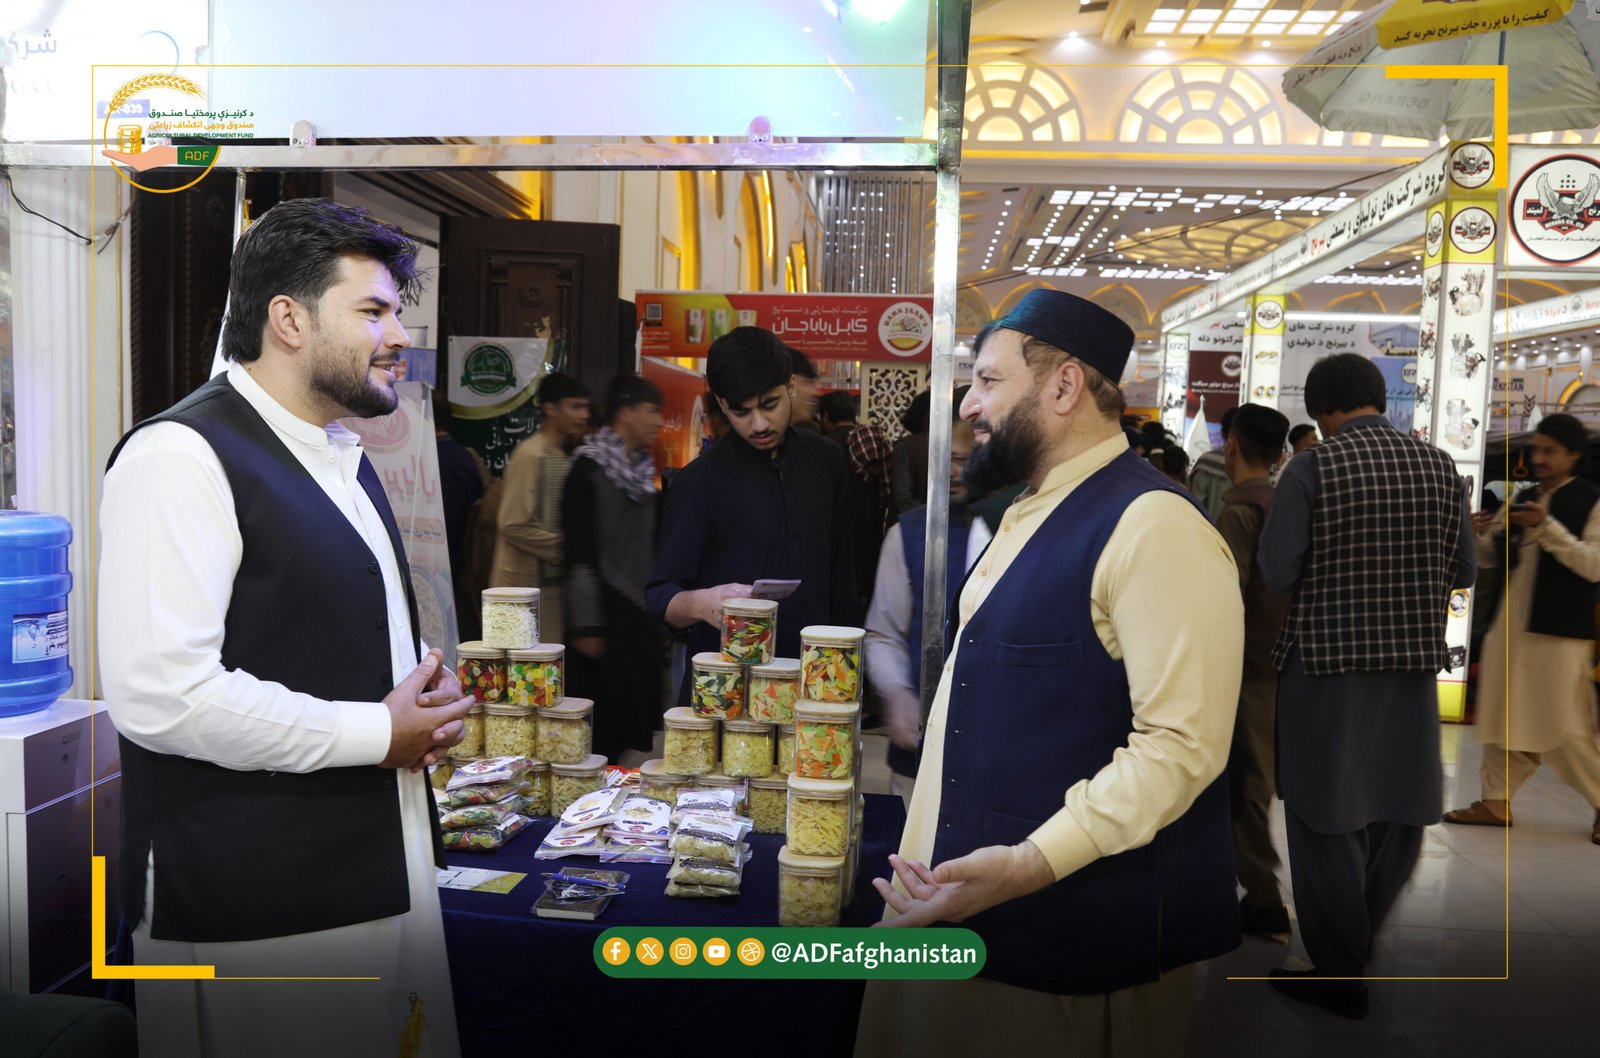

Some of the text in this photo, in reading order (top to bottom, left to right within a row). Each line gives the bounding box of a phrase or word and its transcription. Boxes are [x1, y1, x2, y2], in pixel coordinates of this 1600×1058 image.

[1502, 15, 1510, 25] با
[1512, 14, 1520, 25] را
[1522, 8, 1549, 22] کیفیت
[1461, 20, 1479, 32] جات
[1396, 171, 1423, 206] شرکت
[1379, 190, 1394, 222] های
[828, 318, 868, 336] کابل
[1289, 322, 1356, 334] گروه شرکت های
